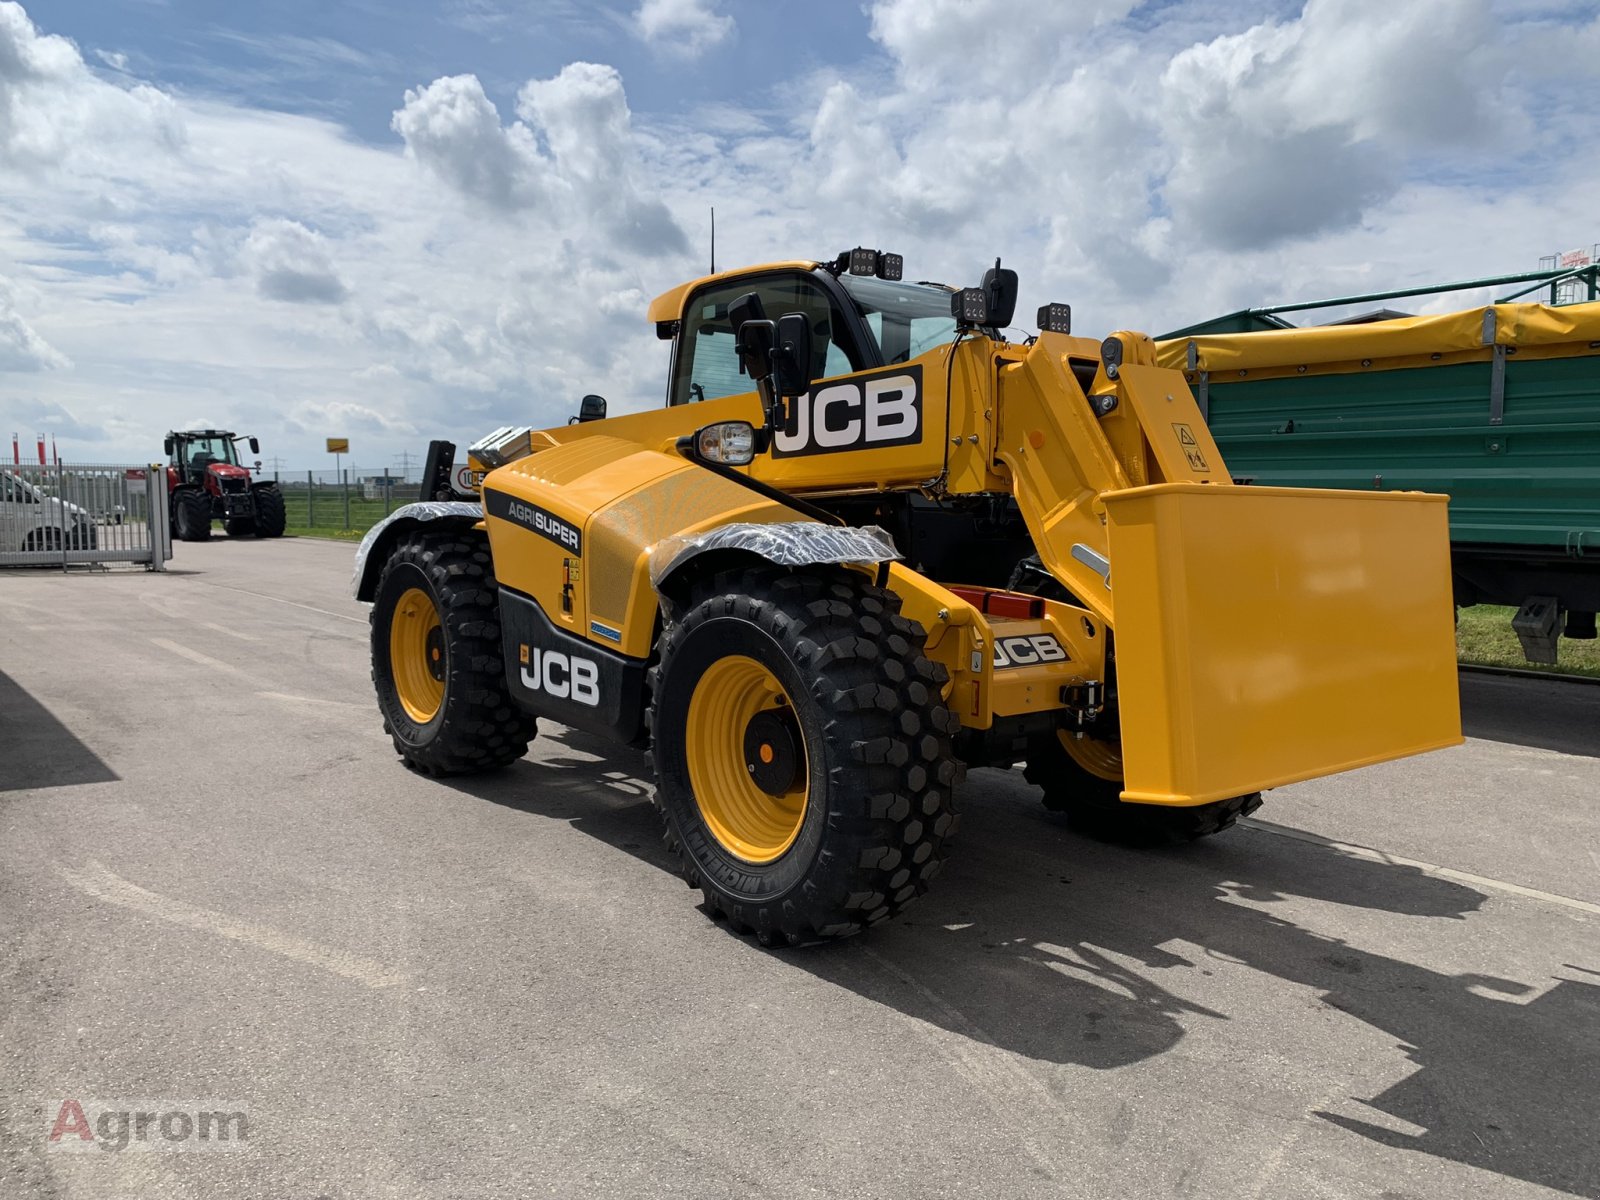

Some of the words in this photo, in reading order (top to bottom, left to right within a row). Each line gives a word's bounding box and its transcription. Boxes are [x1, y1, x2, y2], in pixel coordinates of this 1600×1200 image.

[775, 375, 918, 452] JCB
[508, 502, 578, 549] AGRISUPER
[520, 647, 599, 706] JCB
[686, 831, 762, 894] MICHELIN
